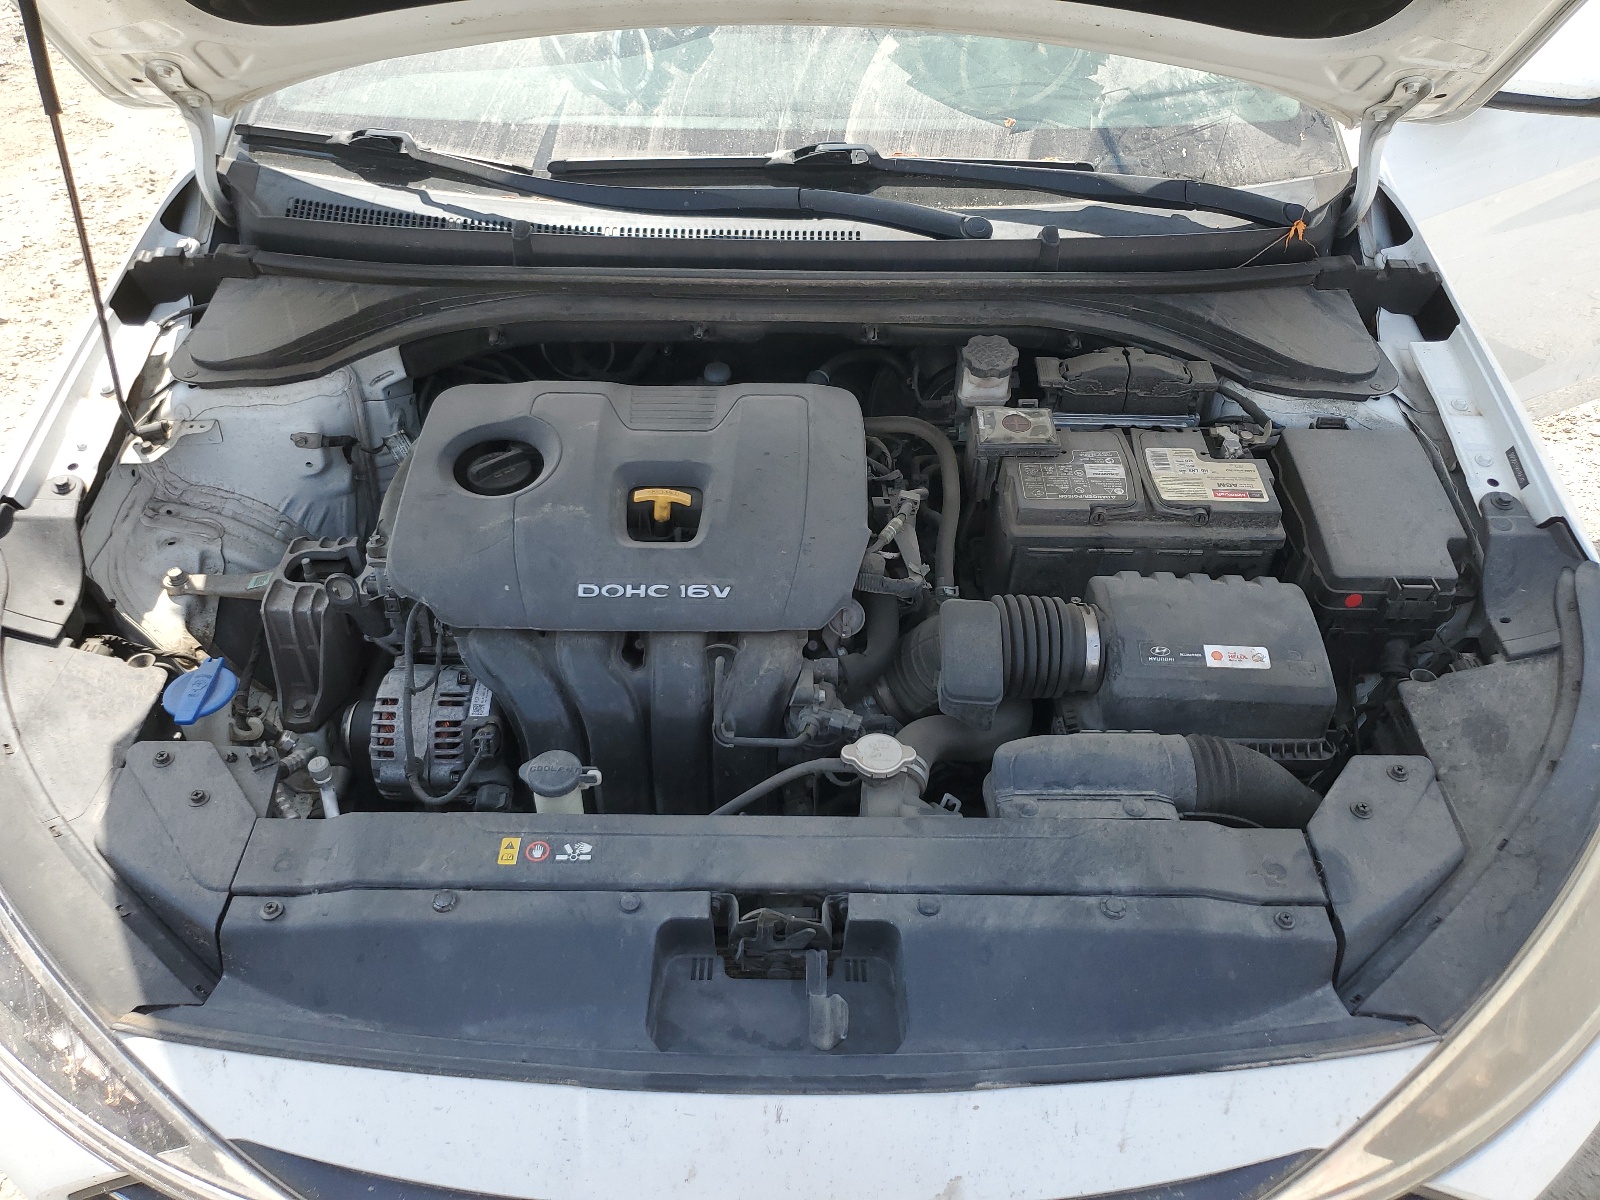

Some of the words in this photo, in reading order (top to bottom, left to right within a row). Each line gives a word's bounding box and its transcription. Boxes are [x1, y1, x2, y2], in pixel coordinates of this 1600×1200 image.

[577, 583, 670, 598] DOHC
[680, 584, 732, 598] 16V
[529, 765, 581, 774] COOLANT
